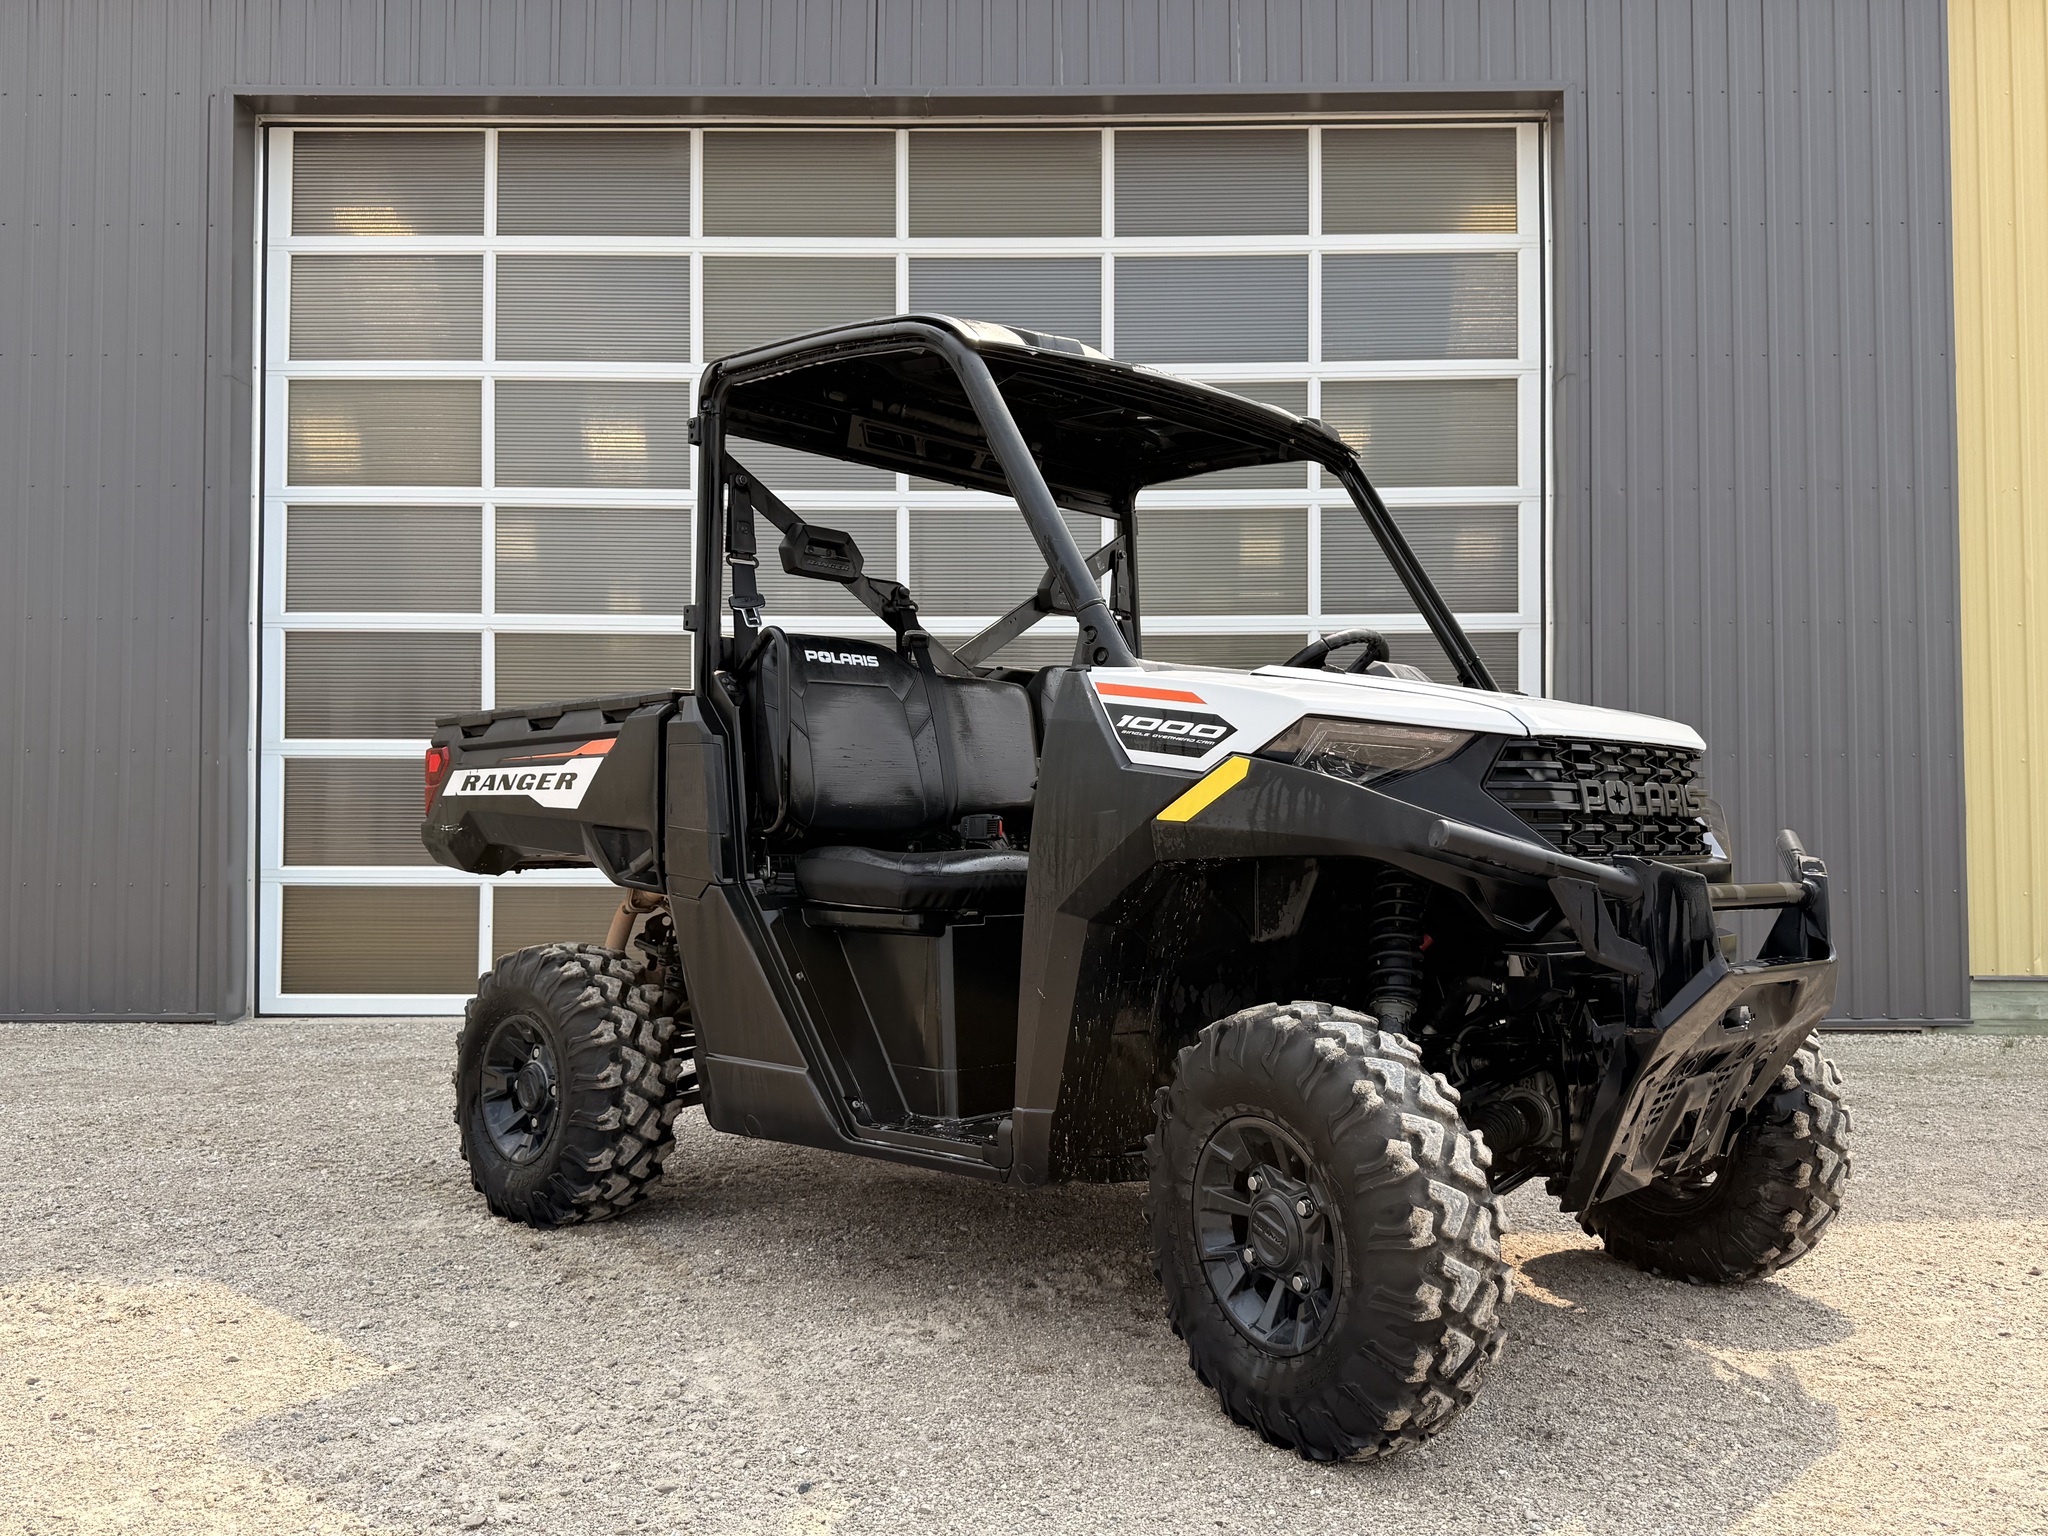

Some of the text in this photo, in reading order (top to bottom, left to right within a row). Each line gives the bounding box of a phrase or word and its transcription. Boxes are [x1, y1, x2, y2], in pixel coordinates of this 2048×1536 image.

[806, 559, 850, 571] RANGER
[804, 650, 879, 667] POLARIS
[1116, 714, 1227, 739] 1000
[460, 772, 578, 791] RANGER
[1578, 779, 1702, 818] POLARIS
